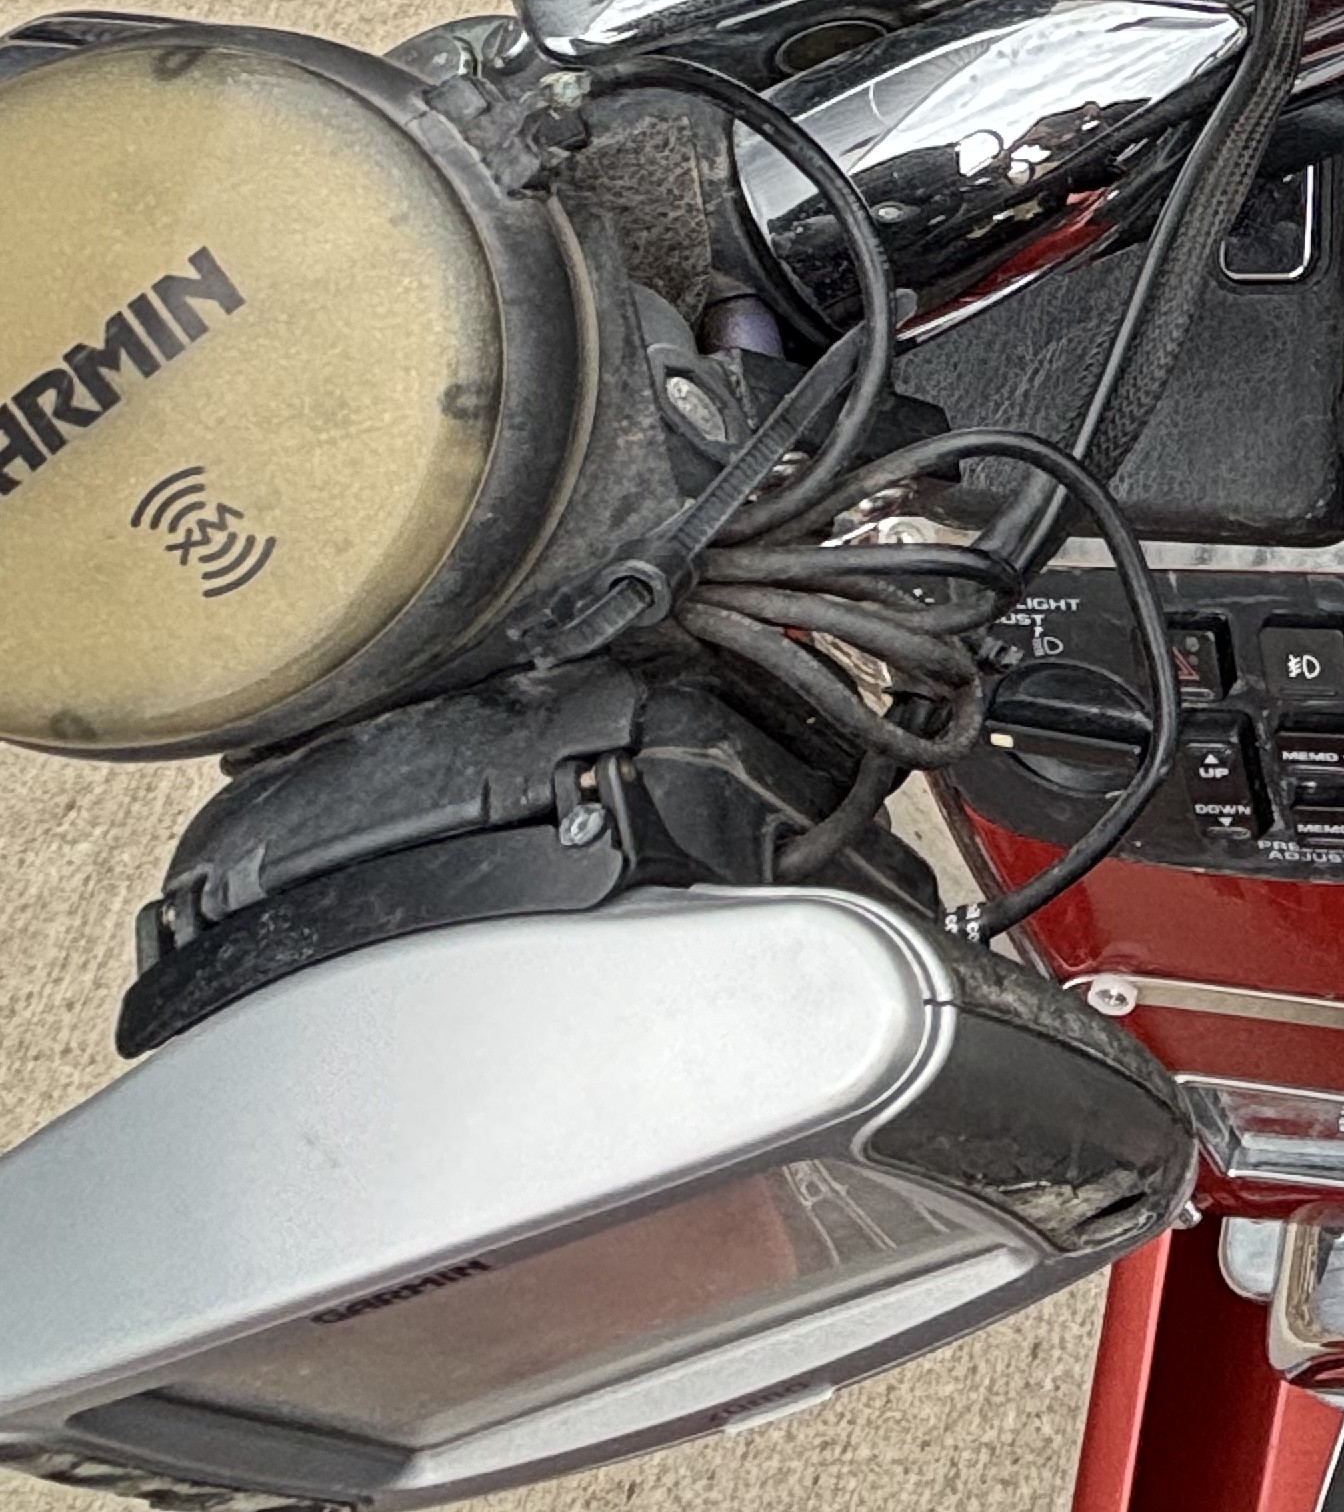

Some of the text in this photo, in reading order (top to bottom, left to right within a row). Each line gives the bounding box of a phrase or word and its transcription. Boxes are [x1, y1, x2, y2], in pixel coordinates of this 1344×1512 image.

[1282, 750, 1339, 762] MEMO
[1199, 767, 1230, 779] UP
[1194, 804, 1251, 816] DOWN
